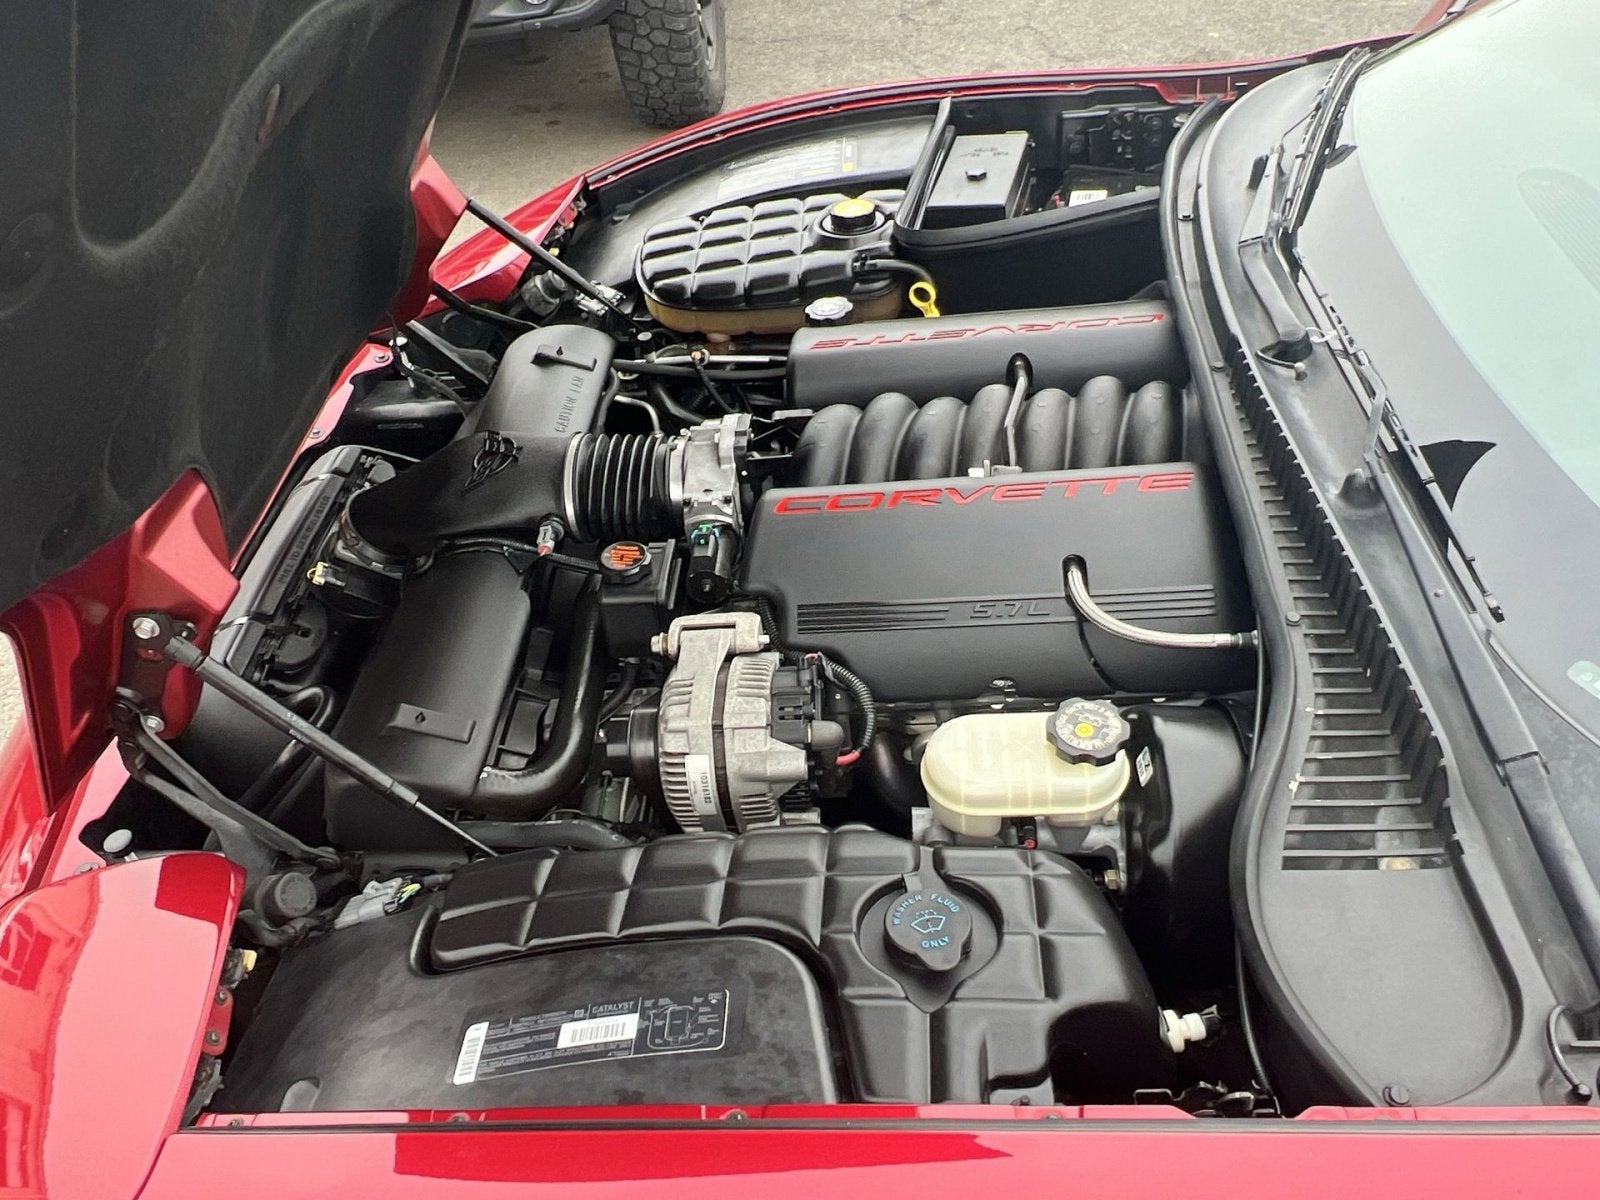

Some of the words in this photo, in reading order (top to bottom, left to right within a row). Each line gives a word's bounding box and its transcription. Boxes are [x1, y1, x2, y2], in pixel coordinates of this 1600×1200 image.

[808, 313, 1165, 350] CORVETTE
[773, 472, 1196, 515] CORVETTE
[969, 600, 1050, 619] 5.7L
[892, 894, 922, 926] WASHER
[930, 893, 960, 913] FLUID
[921, 935, 950, 948] ONLY
[592, 1001, 634, 1014] CATALYST
